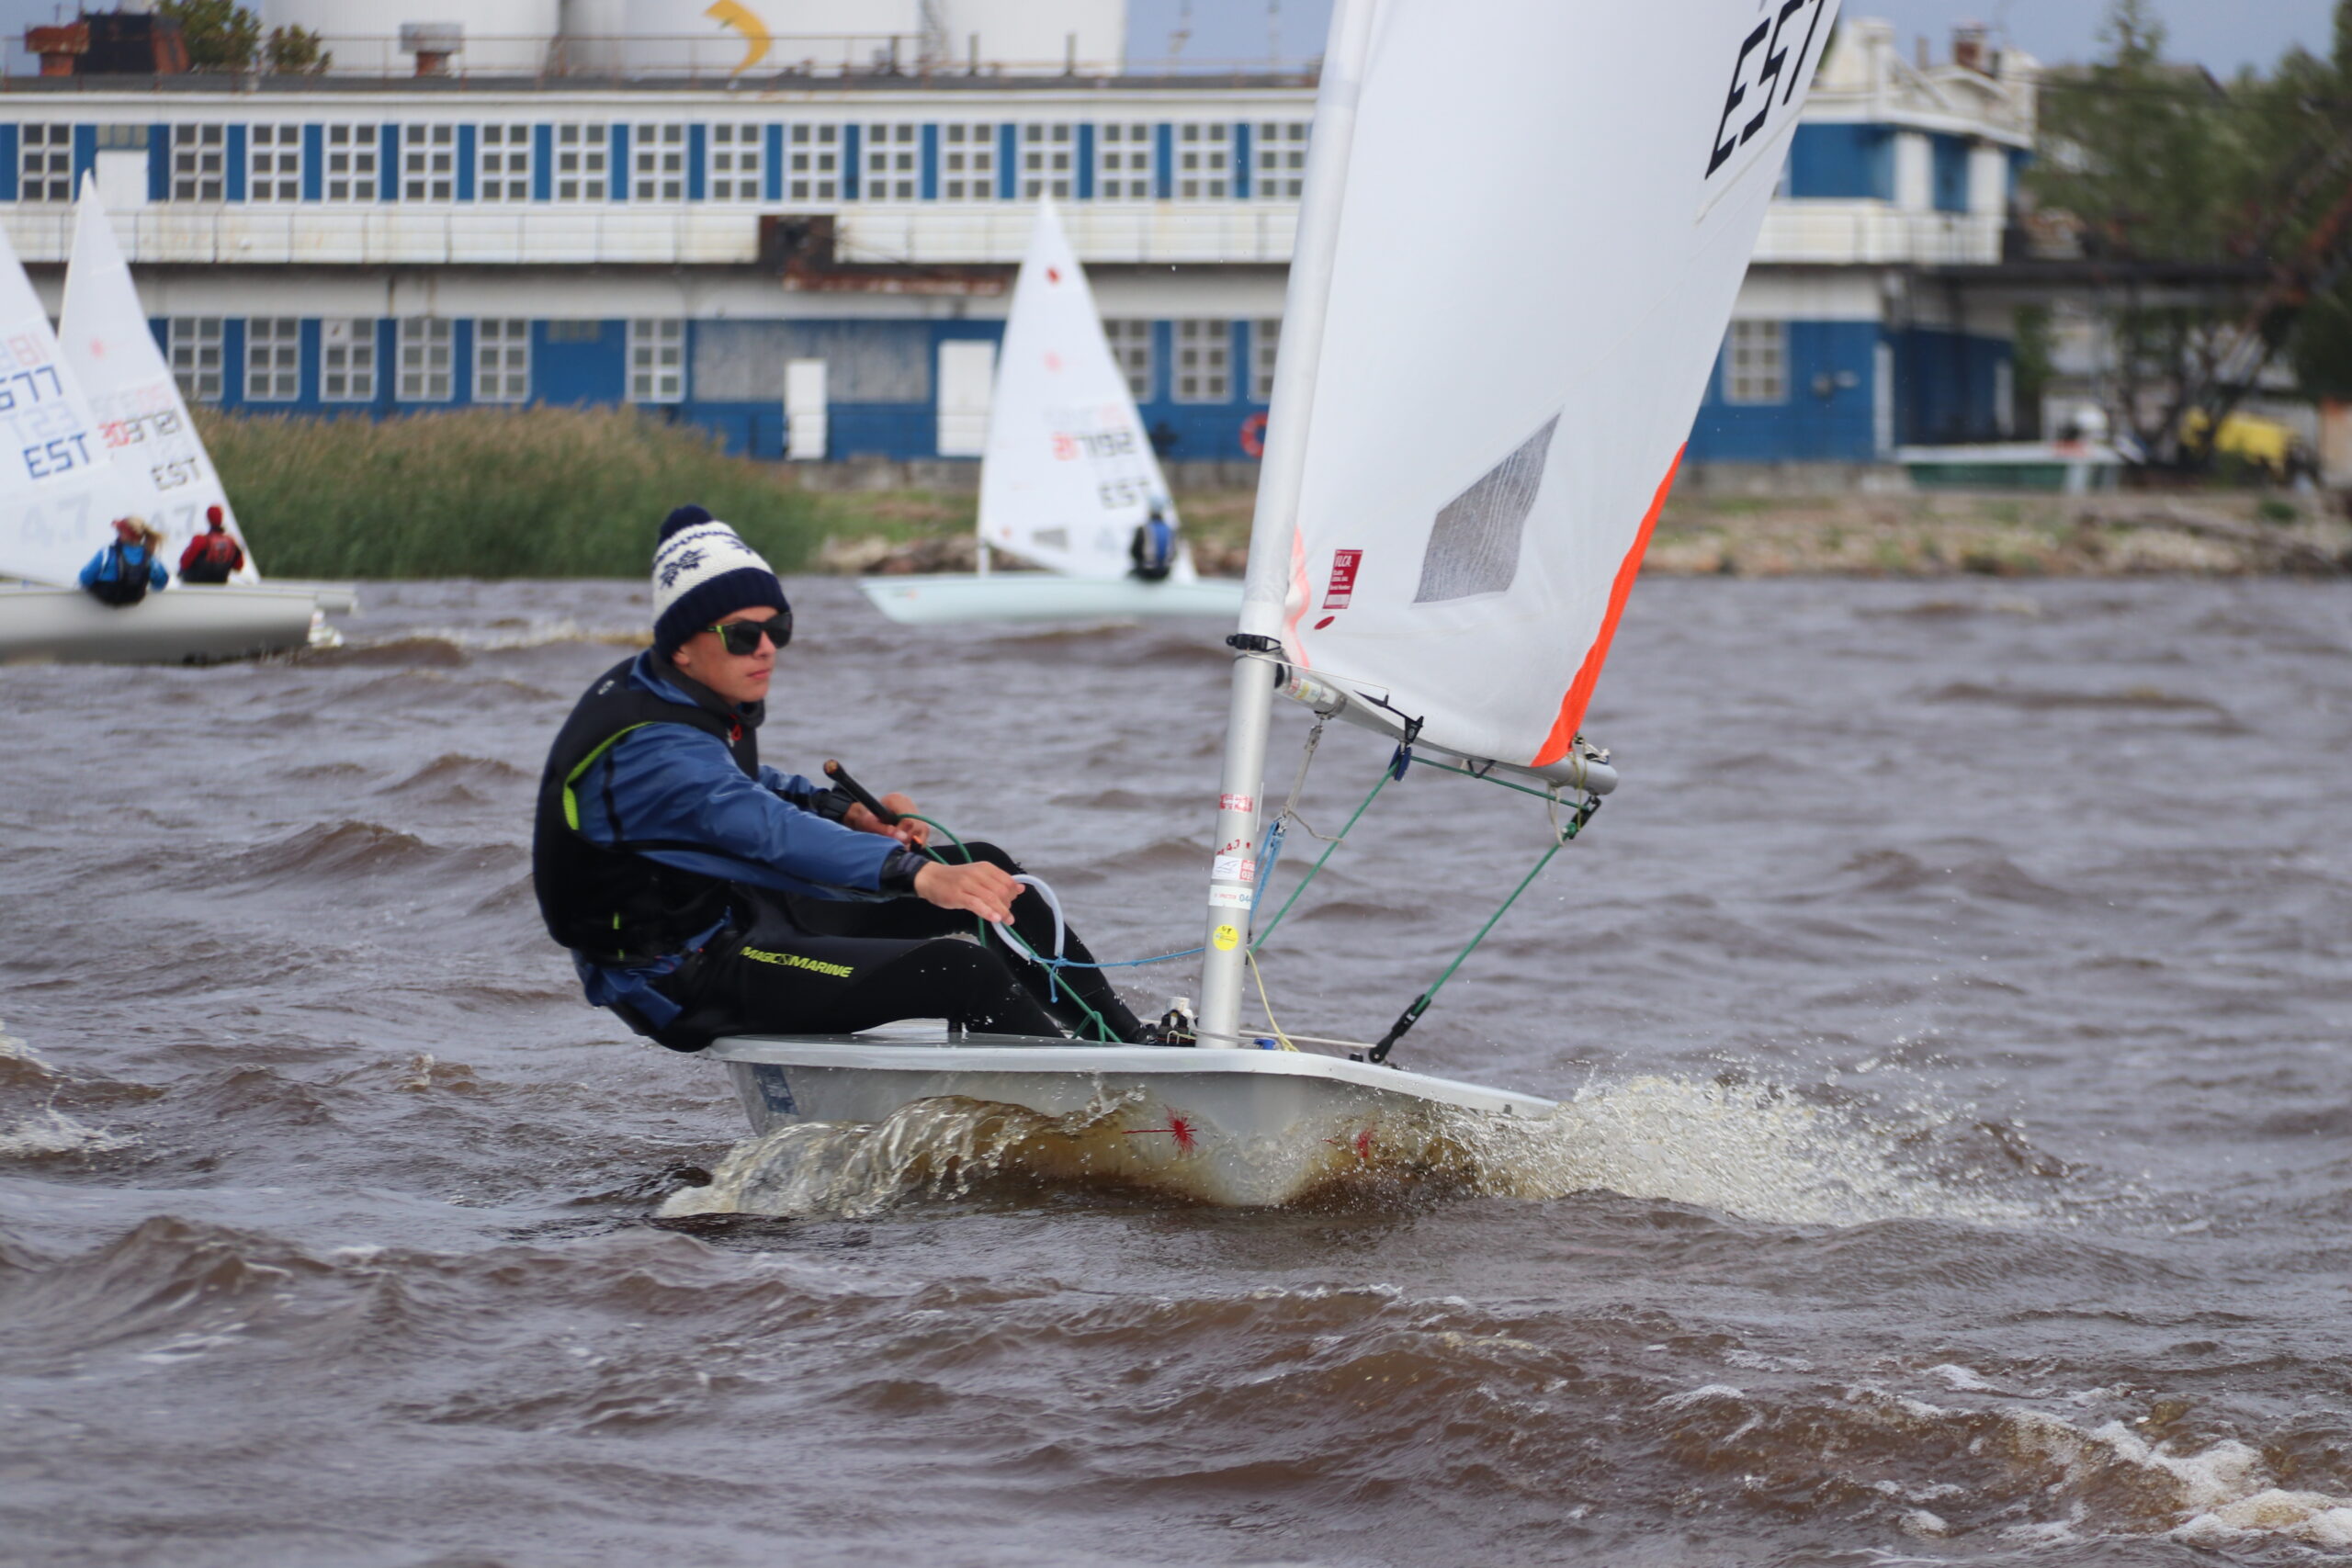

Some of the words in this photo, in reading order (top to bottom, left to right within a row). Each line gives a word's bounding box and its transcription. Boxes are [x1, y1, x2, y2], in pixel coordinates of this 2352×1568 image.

[22, 431, 90, 480] EST
[150, 457, 200, 491] EST
[20, 493, 90, 548] 4.7
[1334, 555, 1352, 567] ILCA
[740, 946, 781, 964] MAGIC
[787, 955, 854, 977] MARINE
